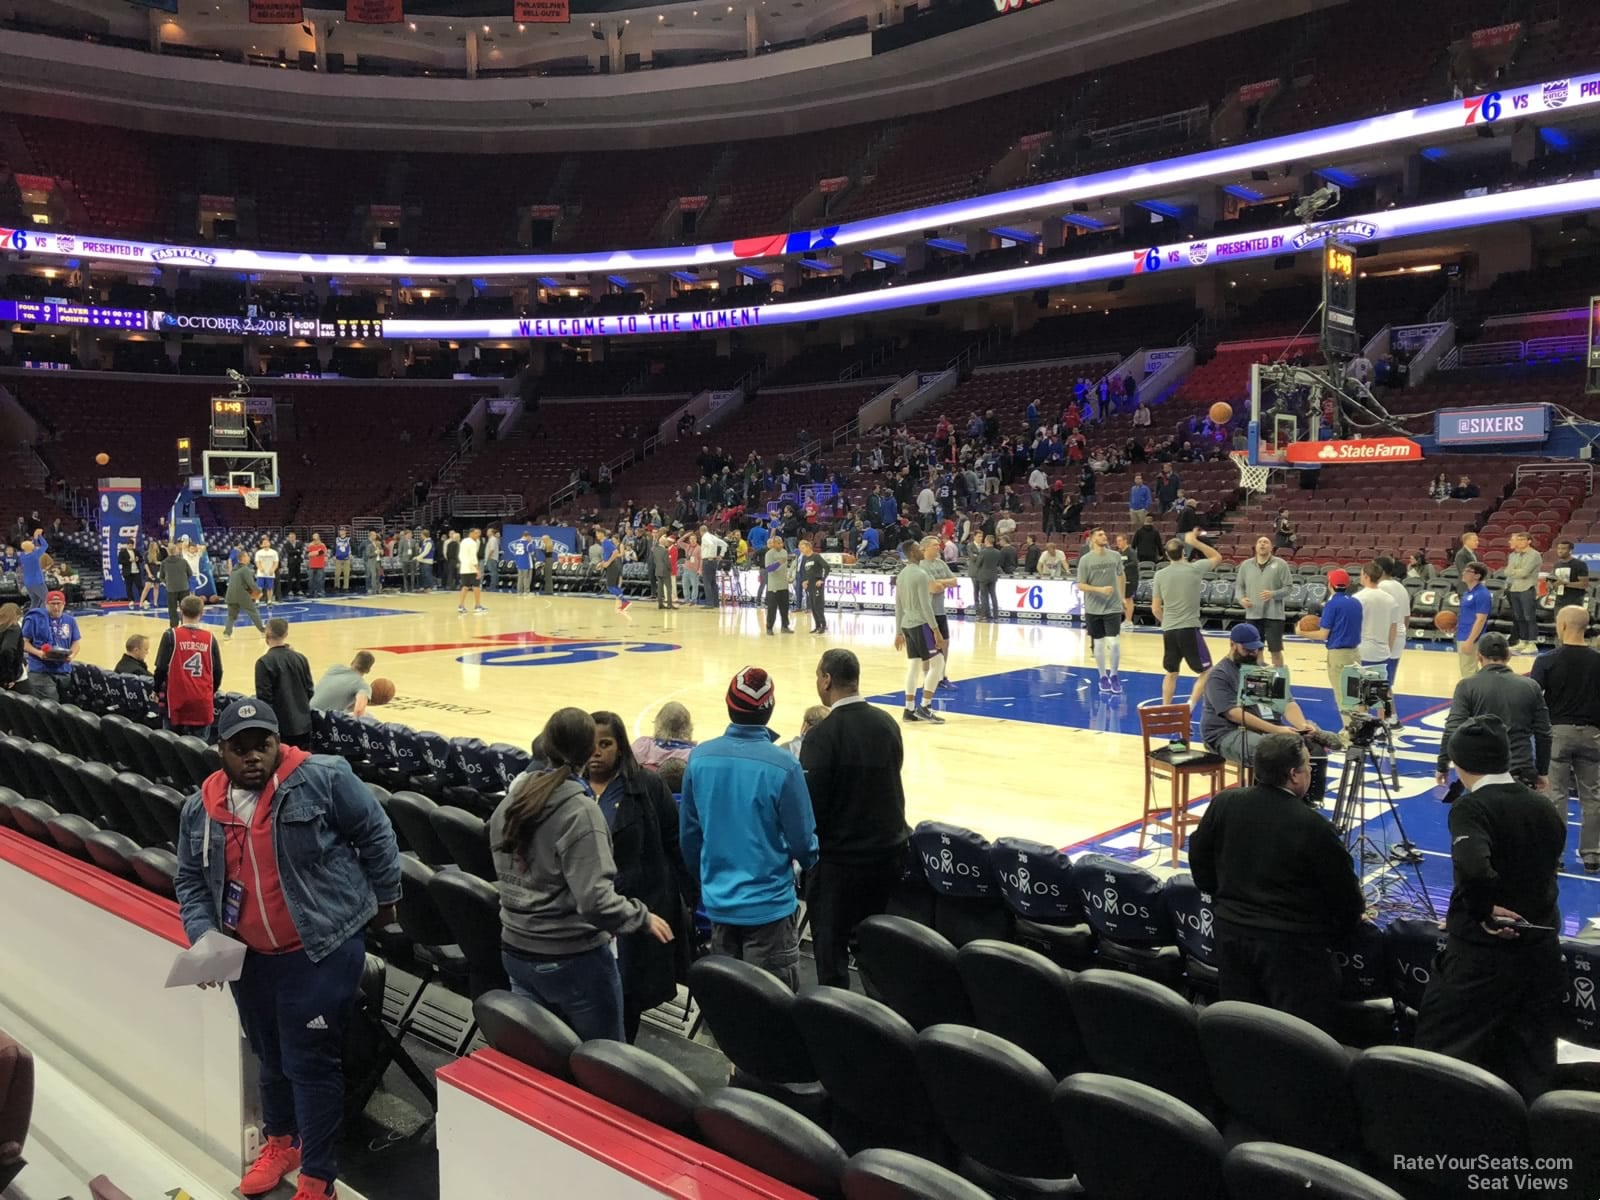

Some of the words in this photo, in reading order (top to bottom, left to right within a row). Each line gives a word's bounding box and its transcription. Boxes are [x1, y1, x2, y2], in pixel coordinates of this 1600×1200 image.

[1463, 92, 1502, 128] 76
[1512, 94, 1529, 110] VS
[0, 228, 27, 250] 76
[82, 241, 131, 255] PRESENTED
[133, 247, 144, 256] BY
[151, 248, 217, 265] TASTYKAKE
[1133, 247, 1161, 274] 76
[1167, 250, 1180, 263] VS
[1216, 239, 1269, 256] PRESENTED
[1271, 234, 1285, 249] BY
[58, 306, 89, 315] PLAYER
[59, 315, 89, 324] POINTS
[177, 315, 240, 330] OCTOBER
[258, 319, 287, 332] 2018
[519, 317, 605, 337] WELCOME
[616, 316, 637, 334] TO
[650, 314, 680, 332] THE
[692, 307, 761, 329] MOMENT
[1459, 416, 1525, 434] @SIXERS
[1339, 444, 1374, 458] State
[1375, 443, 1411, 457] Farm
[825, 579, 866, 595] ELCOME
[871, 581, 884, 597] TO
[1015, 585, 1043, 610] 76
[179, 641, 209, 652] IVERSON
[183, 651, 203, 678] 4
[921, 849, 981, 878] VOMOS
[1000, 868, 1060, 897] VOMOS
[1082, 888, 1150, 918] VOMOS
[1176, 908, 1215, 939] VOM
